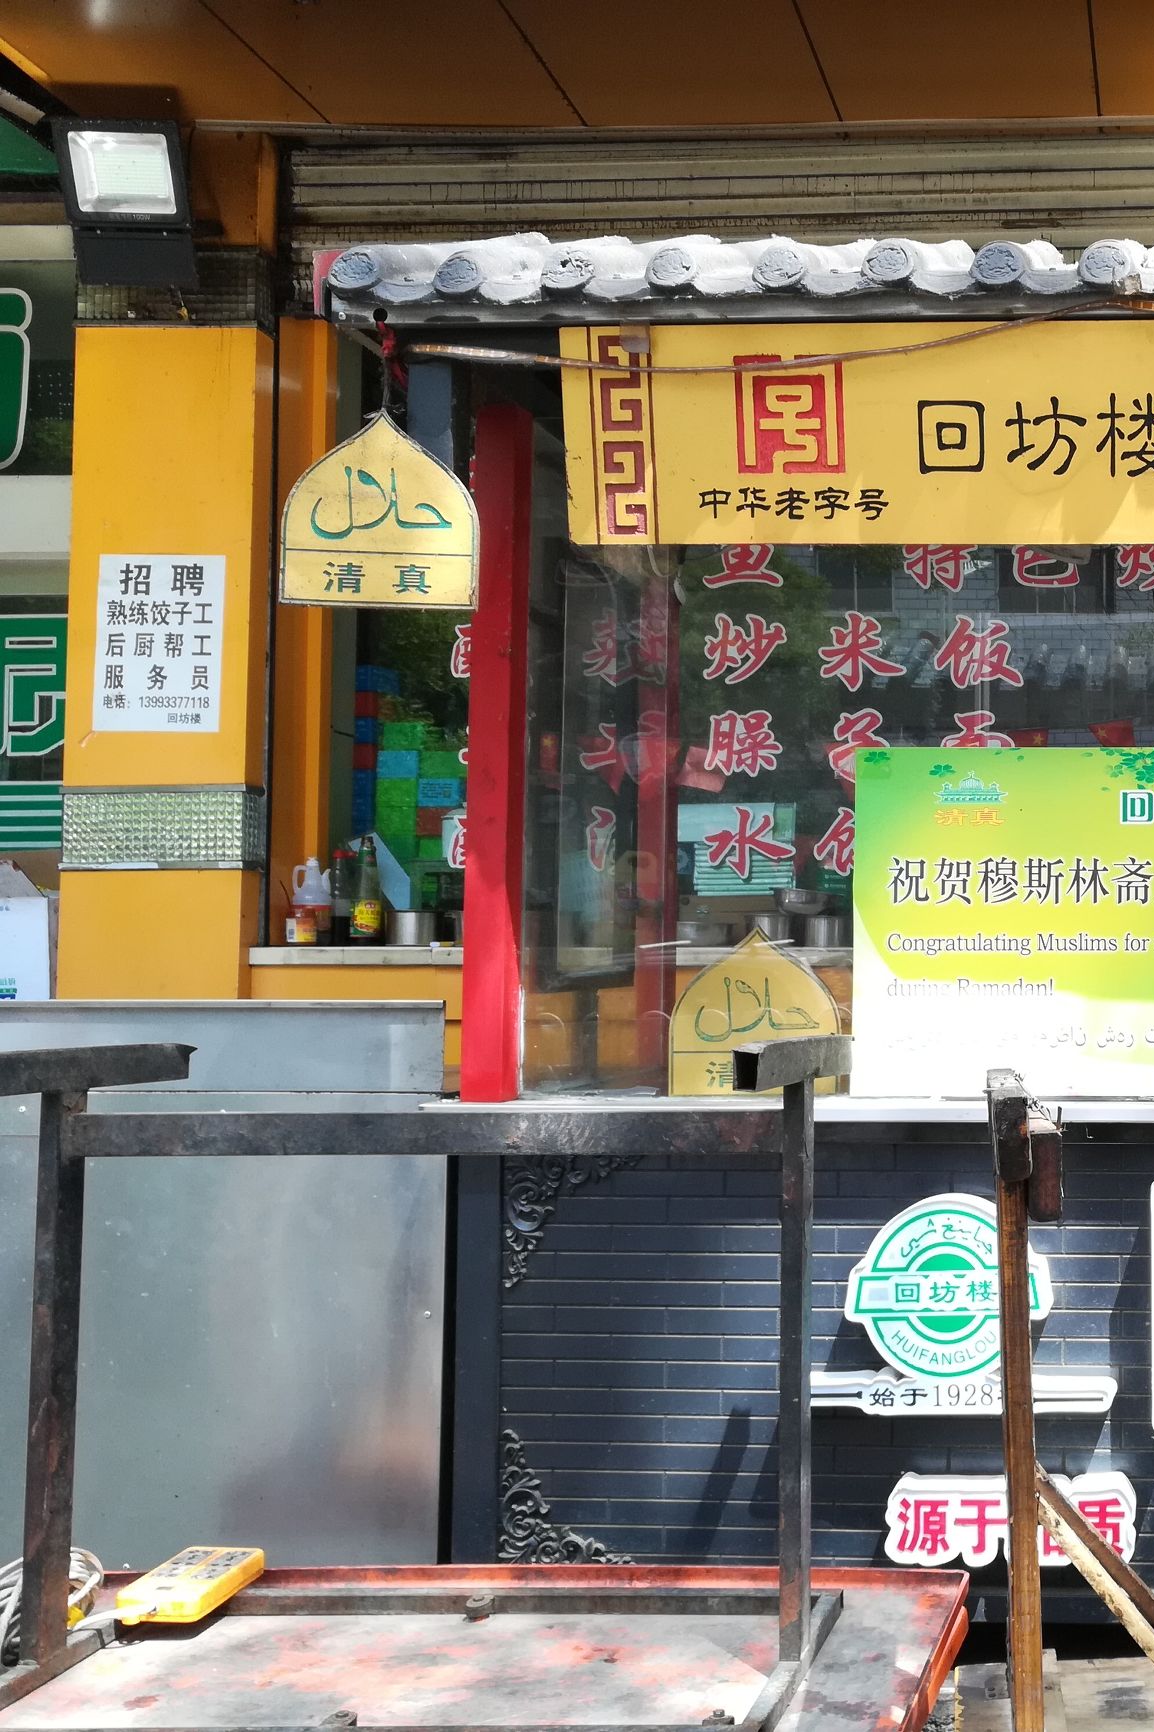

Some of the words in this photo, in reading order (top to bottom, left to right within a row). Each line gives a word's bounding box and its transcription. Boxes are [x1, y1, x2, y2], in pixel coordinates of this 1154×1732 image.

[310, 466, 453, 540] حلال
[699, 488, 890, 520] 中华老字号
[119, 563, 205, 596] 招聘
[322, 561, 432, 594] 清真
[107, 600, 213, 626] 熟练饺子工
[105, 633, 212, 657] 后厨帮工
[103, 664, 209, 690] 服务员
[167, 712, 202, 725] 回坊楼
[934, 807, 1007, 827] 清真
[887, 933, 1031, 956] Congratulating
[1037, 933, 1118, 952] Muslims
[1124, 933, 1150, 952] for
[957, 979, 1054, 997] Ramadan!
[694, 977, 820, 1042] حلال
[895, 1280, 998, 1304] 回坊楼
[891, 1329, 998, 1366] HUIFANGLOU
